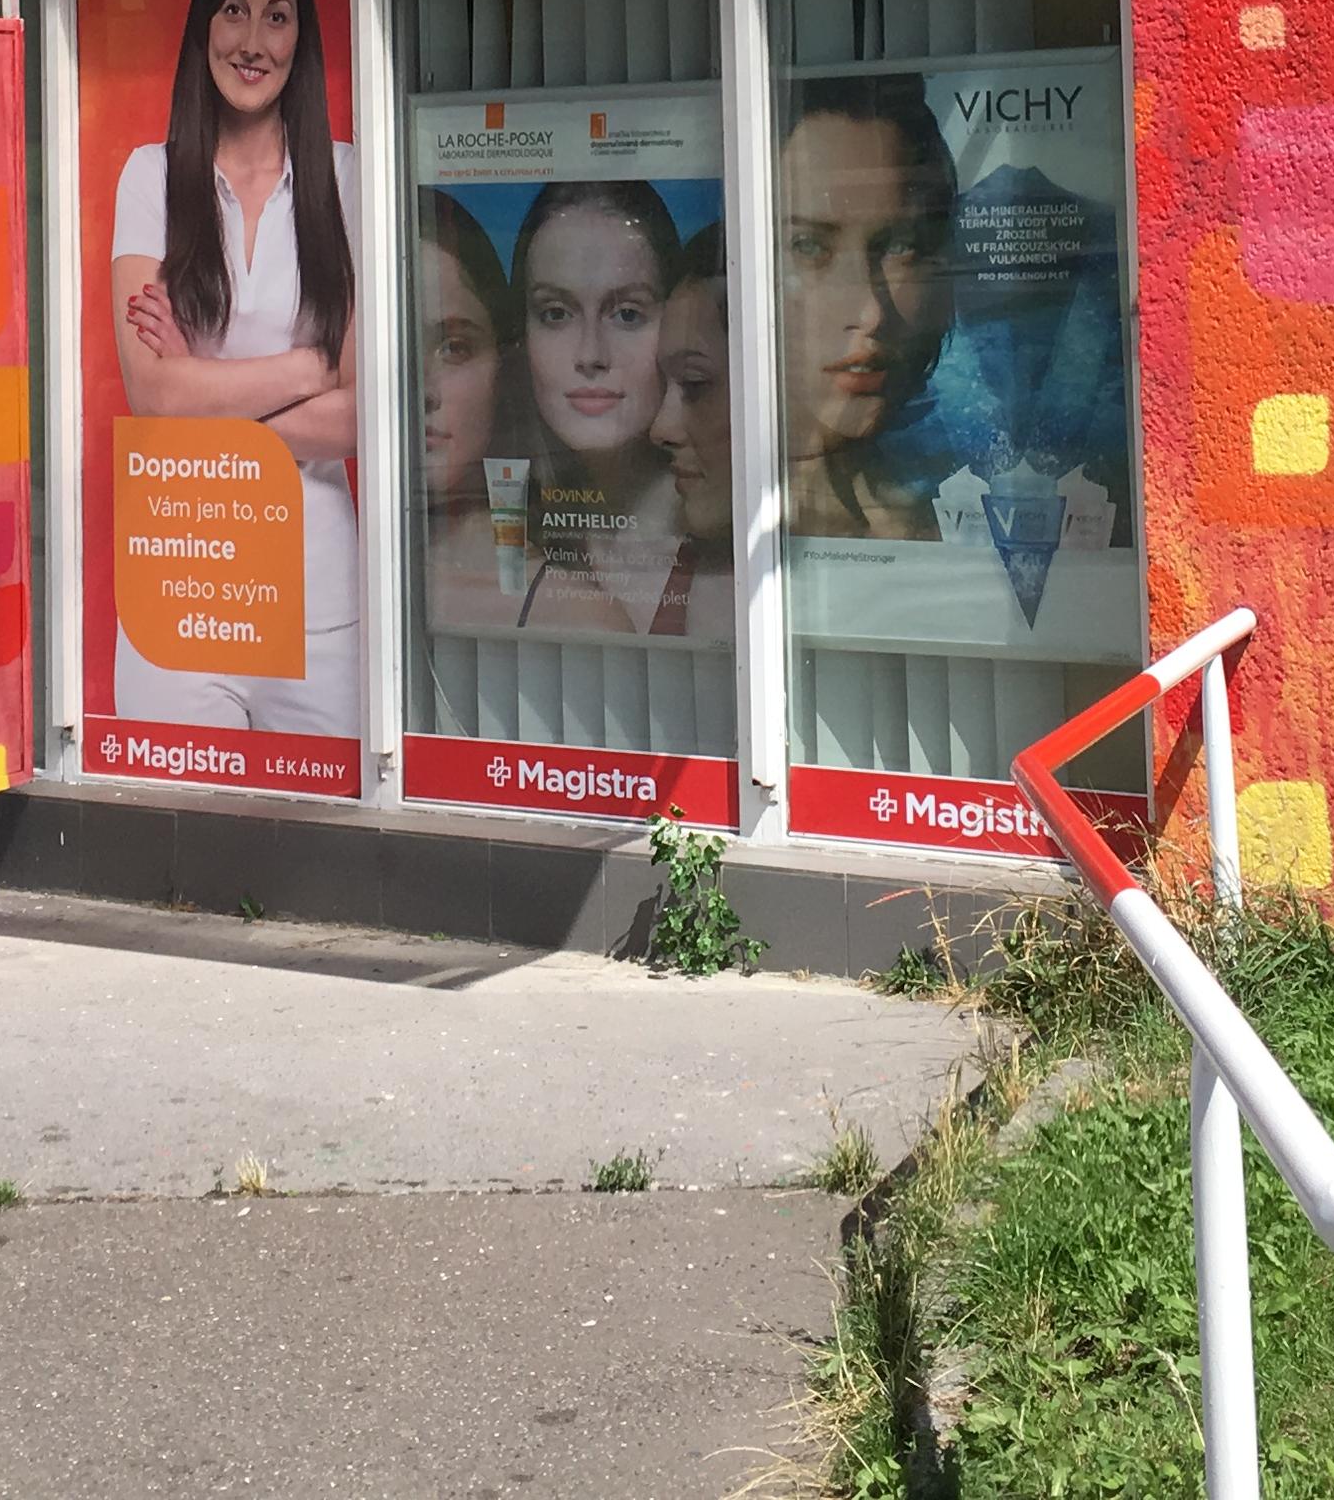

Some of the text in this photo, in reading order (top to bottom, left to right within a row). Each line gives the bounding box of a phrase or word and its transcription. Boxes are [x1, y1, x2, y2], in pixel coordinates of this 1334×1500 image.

[954, 85, 1083, 122] VICHY
[438, 131, 554, 148] LA ROCHE-POSAY
[964, 204, 988, 217] SÍLA
[1018, 218, 1047, 228] VODY
[1050, 216, 1085, 227] VICHY
[965, 242, 980, 253] VE
[129, 452, 260, 481] Doporučím
[148, 496, 289, 523] Vám jen to, co
[541, 488, 605, 504] NOVINKA
[542, 512, 638, 530] ANTHELIOS
[128, 533, 236, 560] mamince
[543, 547, 578, 563] Velmi
[545, 565, 567, 580] Pro
[161, 575, 278, 606] nebo svým
[177, 613, 263, 643] dětem.
[128, 737, 346, 780] Magistra LÉKÁRNY
[518, 760, 657, 802] Magistra
[905, 792, 1053, 837] Magistr
